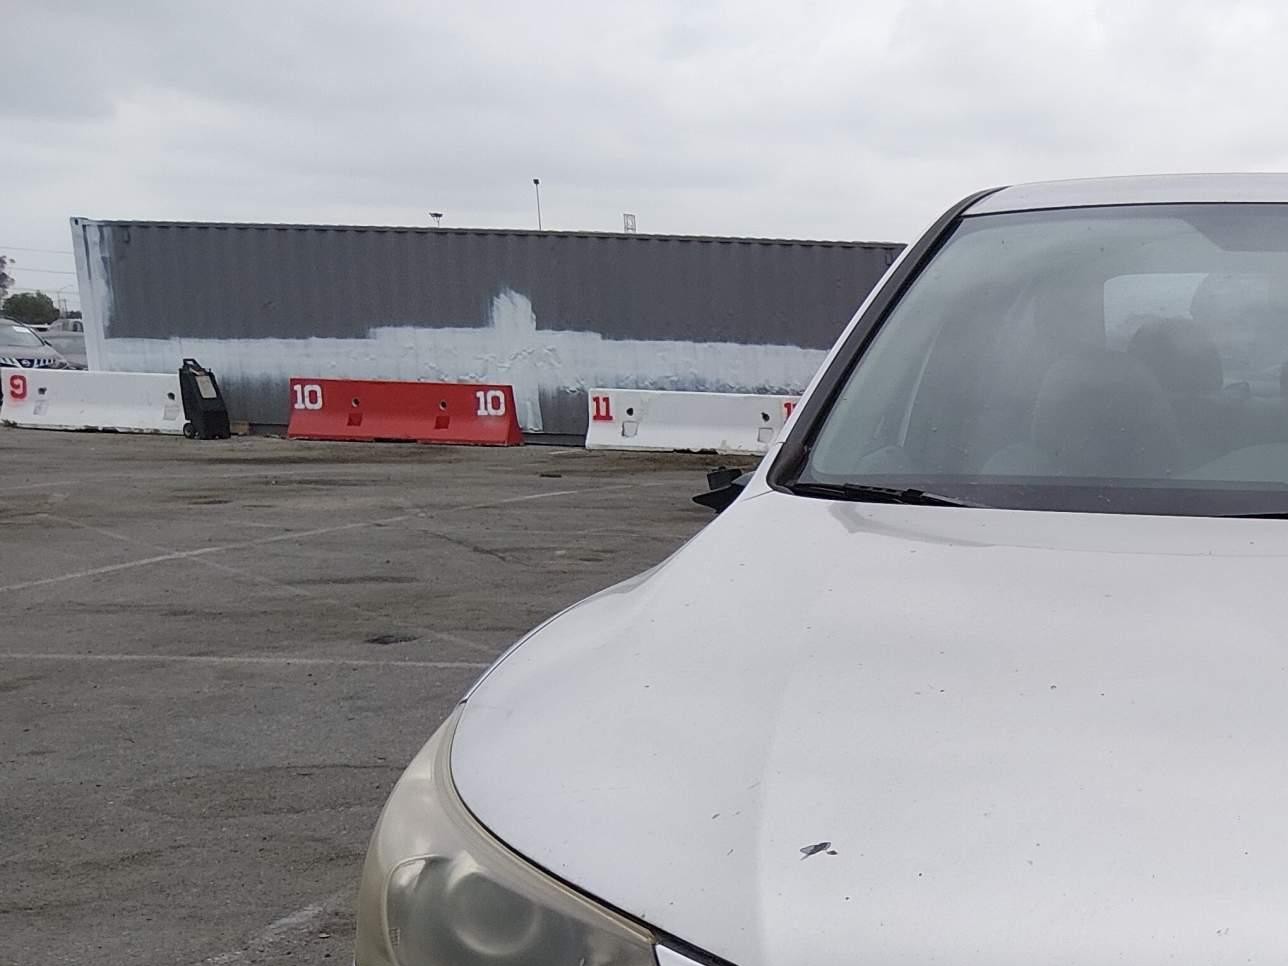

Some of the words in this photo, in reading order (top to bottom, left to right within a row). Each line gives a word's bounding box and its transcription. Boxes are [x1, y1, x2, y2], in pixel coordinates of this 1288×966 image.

[9, 374, 27, 400] 9
[293, 384, 323, 410] 10
[475, 389, 506, 416] 10
[592, 396, 613, 421] 11
